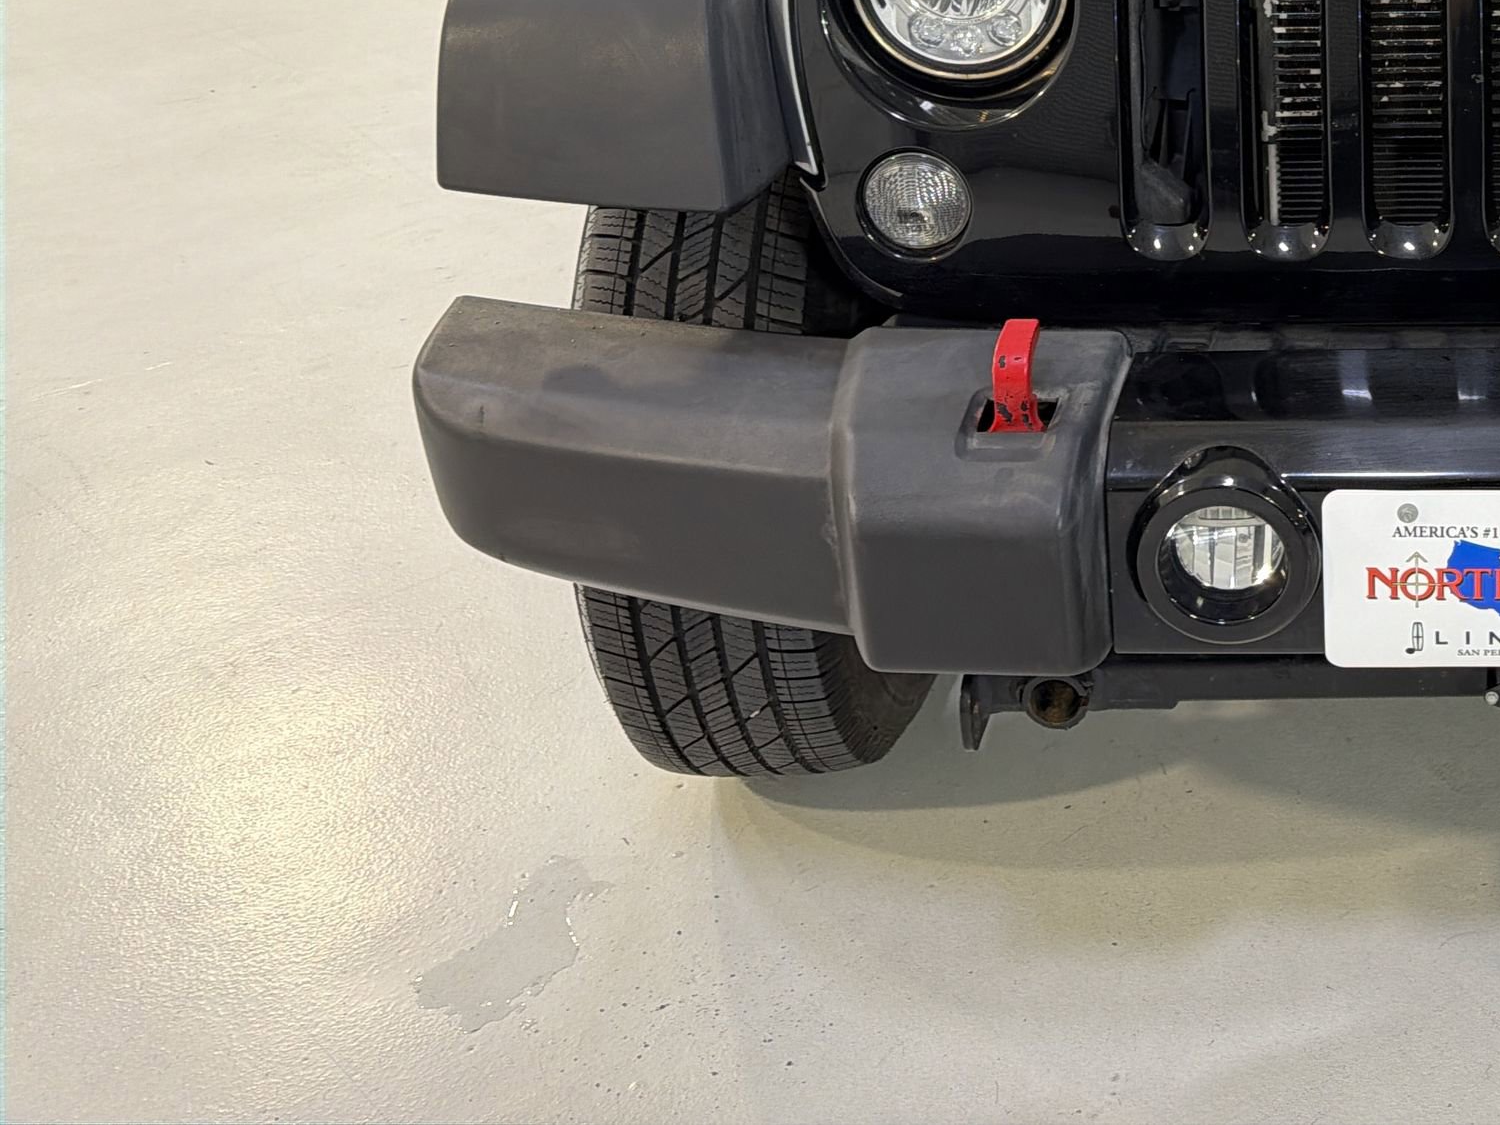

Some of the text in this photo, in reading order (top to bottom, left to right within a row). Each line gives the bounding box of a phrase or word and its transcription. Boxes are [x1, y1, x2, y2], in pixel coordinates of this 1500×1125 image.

[1392, 526, 1479, 539] AMERICA'S
[1482, 526, 1499, 539] #1
[1457, 648, 1481, 657] SAN
